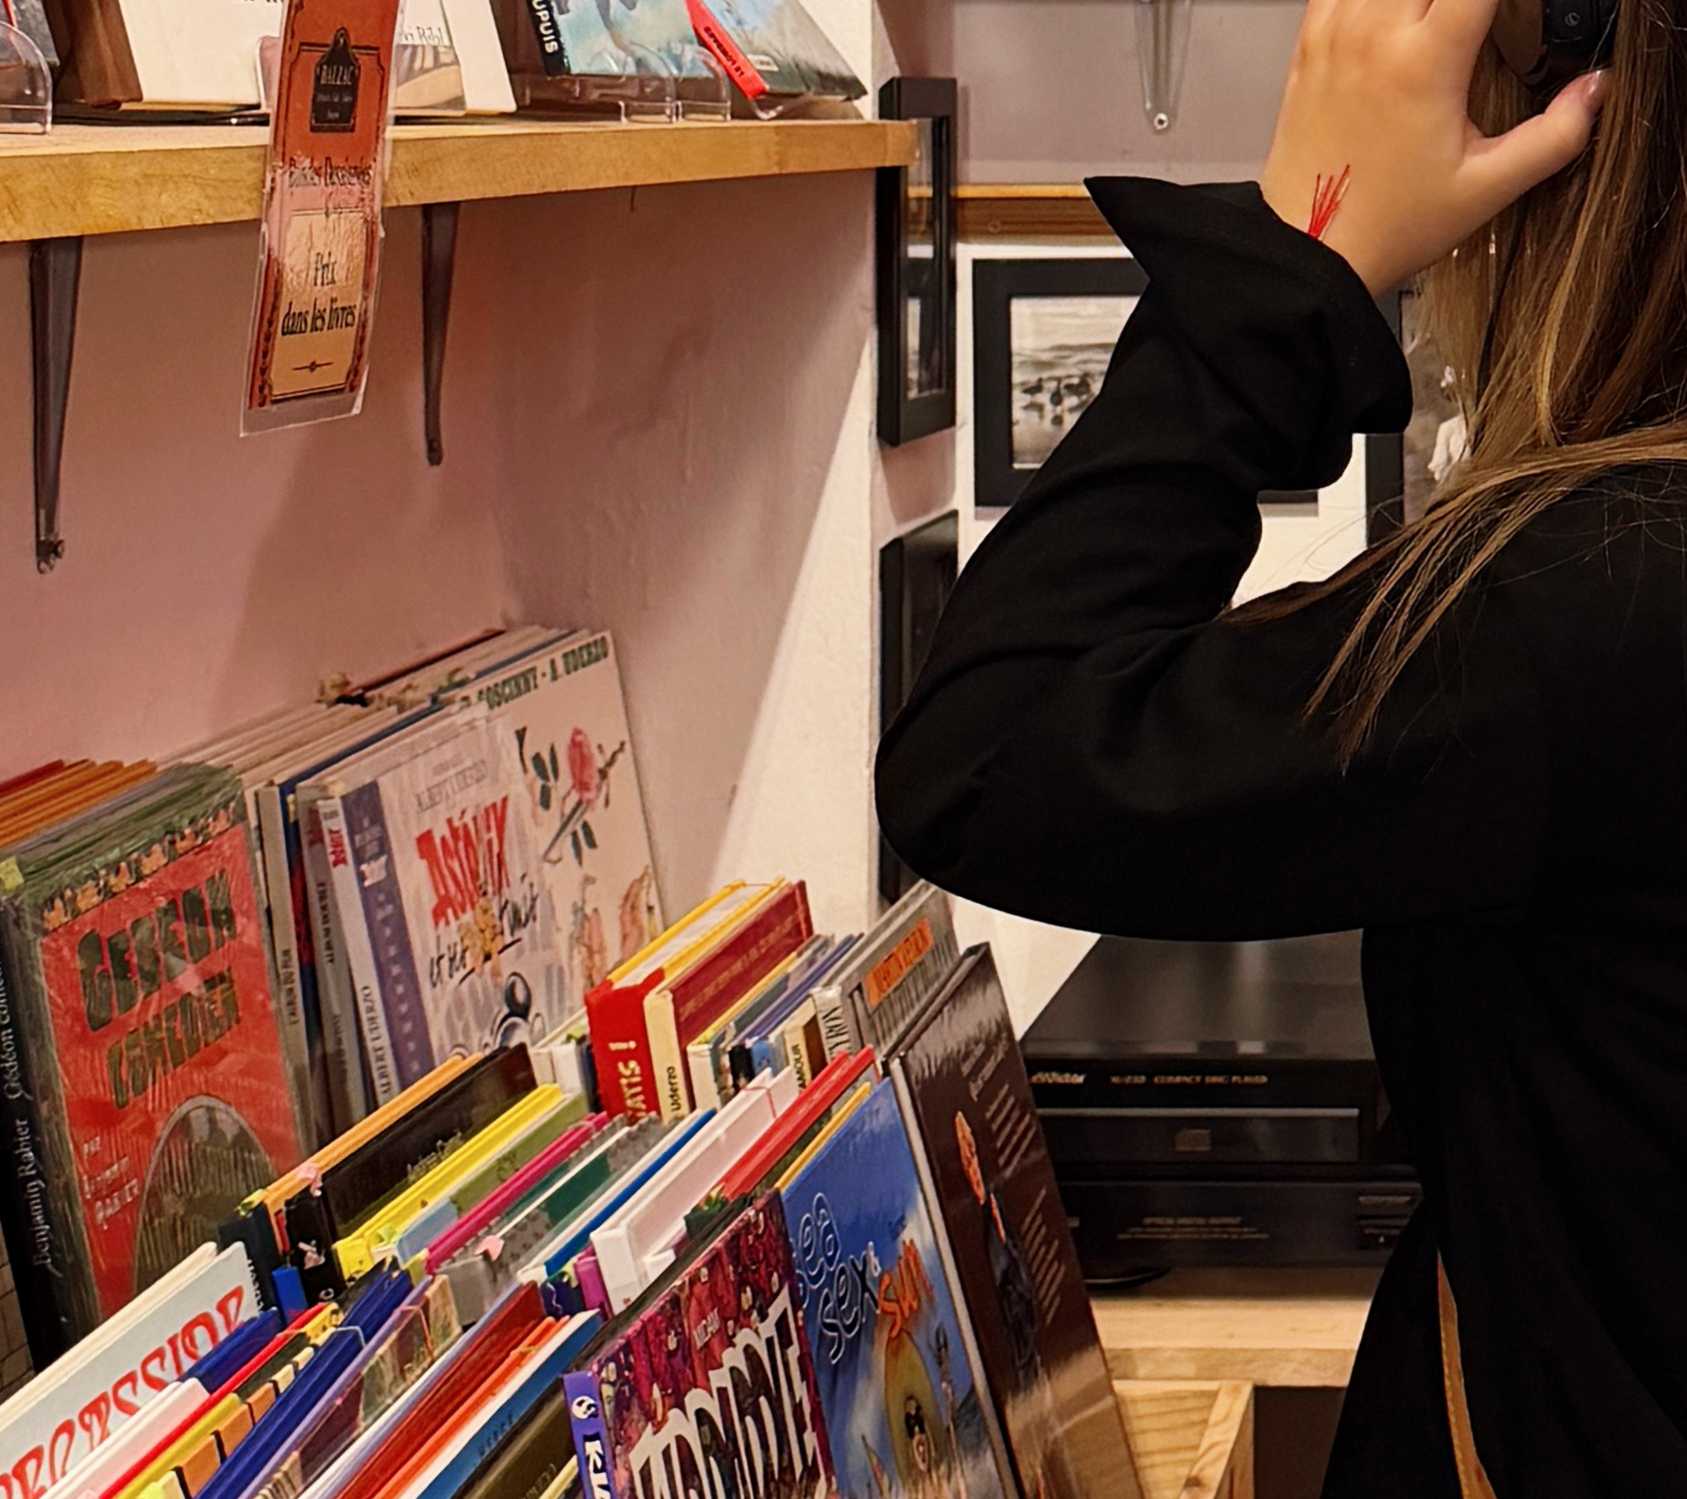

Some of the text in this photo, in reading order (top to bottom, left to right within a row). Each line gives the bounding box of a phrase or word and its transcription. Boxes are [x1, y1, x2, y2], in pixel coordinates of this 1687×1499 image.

[313, 251, 337, 288] Prix
[281, 297, 357, 337] dans les livres
[667, 1064, 682, 1113] Uderzo
[14, 1117, 38, 1178] Rabier
